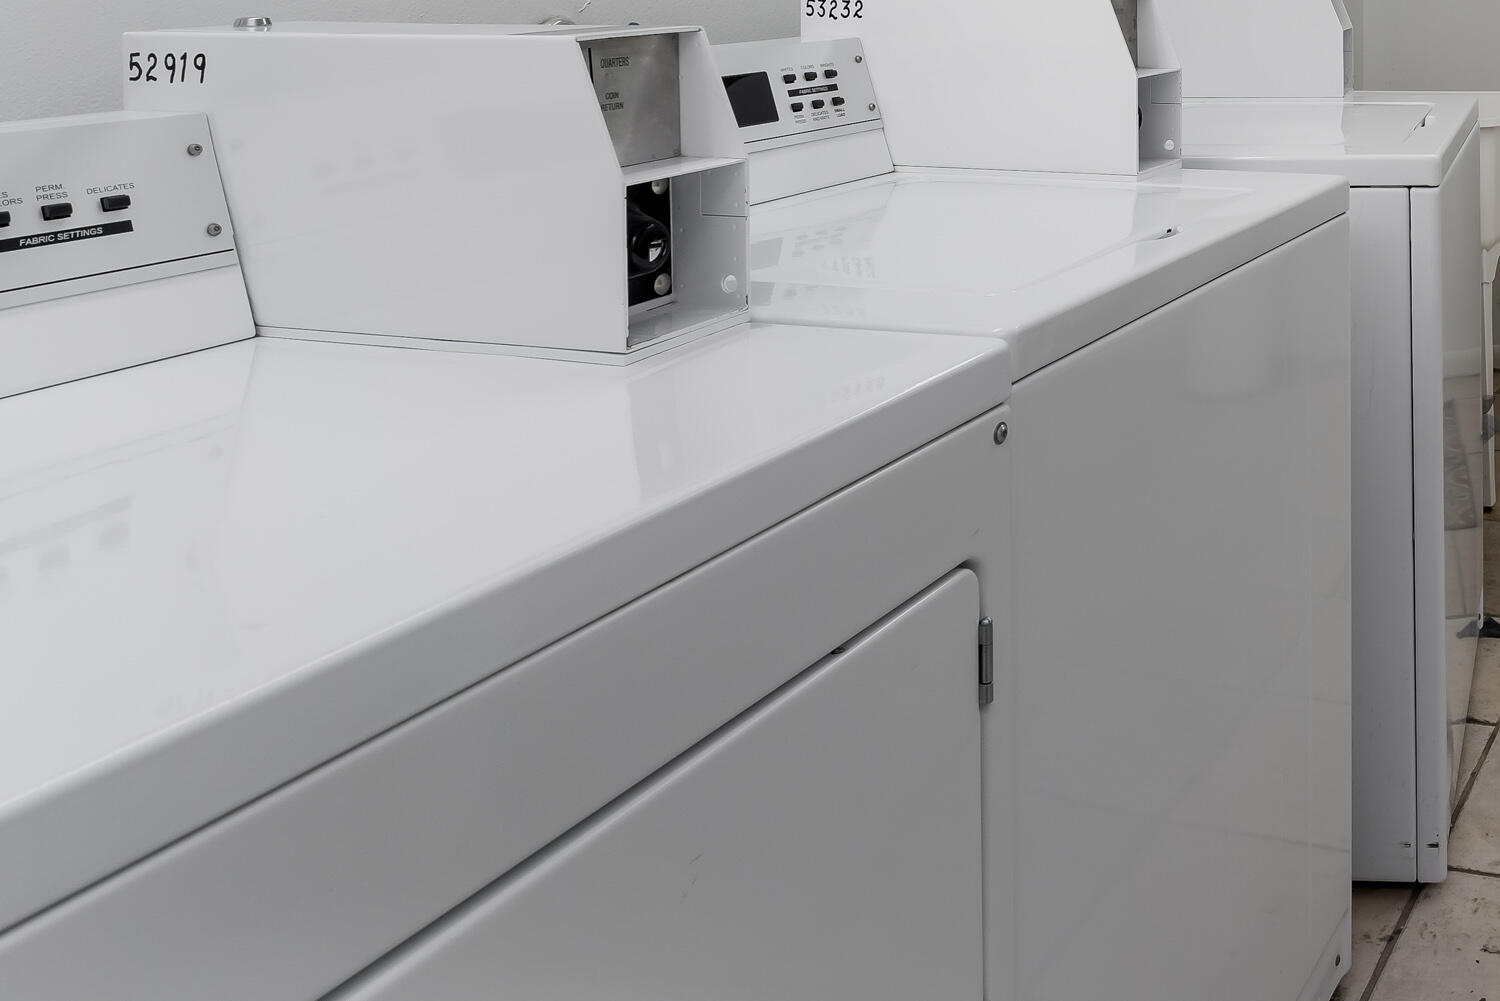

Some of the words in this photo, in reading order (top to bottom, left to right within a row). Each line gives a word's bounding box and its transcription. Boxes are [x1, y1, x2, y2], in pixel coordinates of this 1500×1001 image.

[805, 0, 864, 20] 53232
[129, 52, 206, 84] 52919
[600, 56, 630, 69] QUARTERS
[605, 91, 619, 100] COIN
[35, 183, 63, 193] PERM
[86, 182, 135, 195] DELICATES
[36, 191, 69, 201] PRESS
[19, 234, 55, 247] FABRIC
[56, 226, 104, 240] SETTINGS
